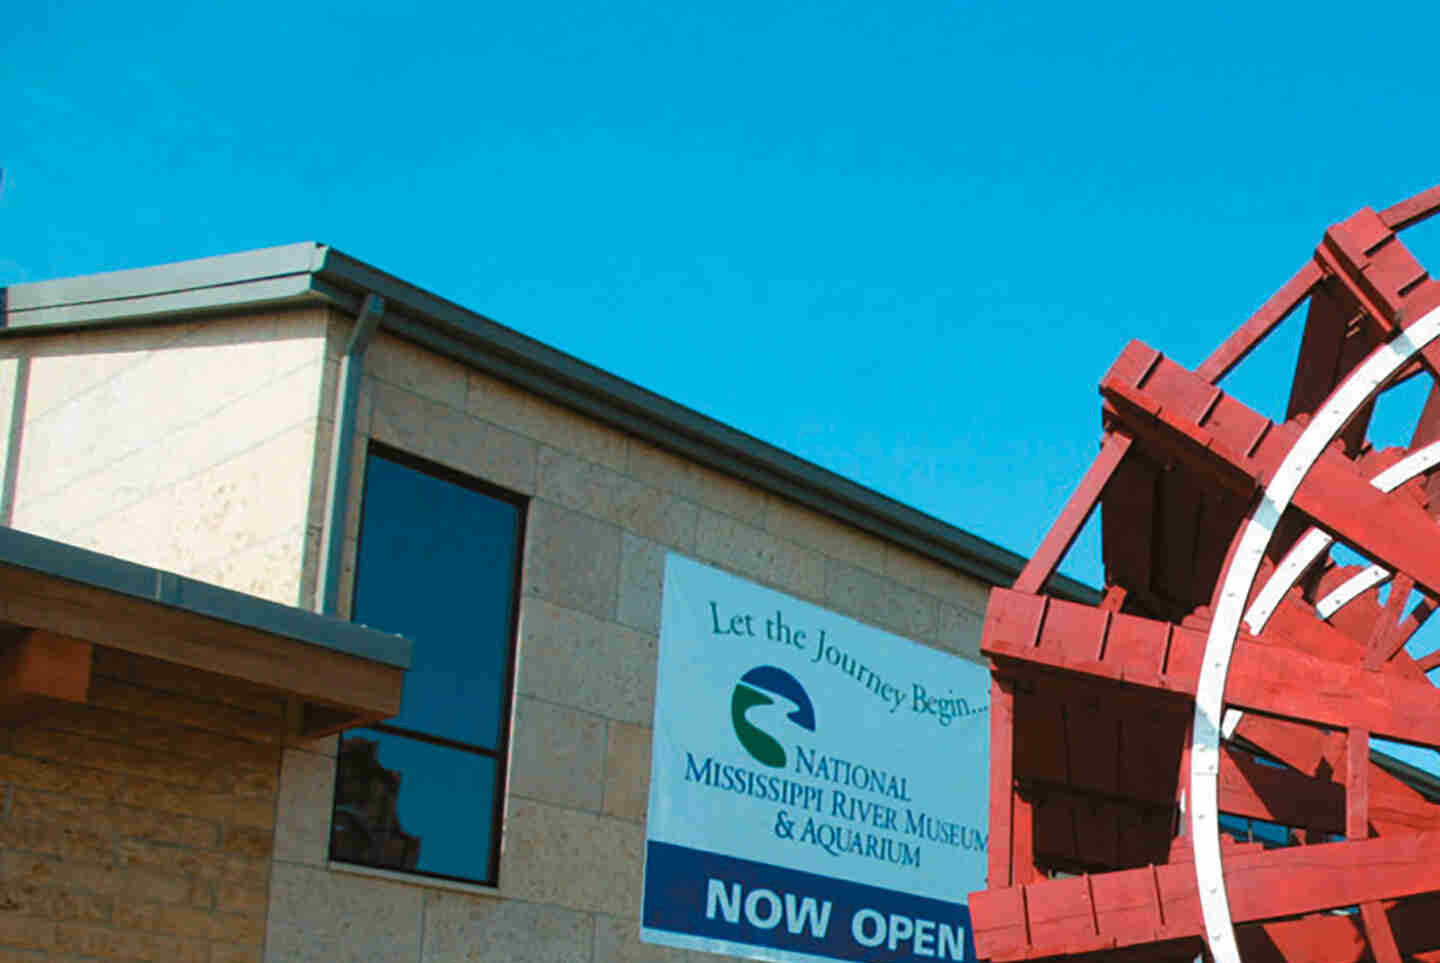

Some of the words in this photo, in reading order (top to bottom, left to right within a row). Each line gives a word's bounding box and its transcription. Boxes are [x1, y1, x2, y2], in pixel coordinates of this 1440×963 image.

[709, 600, 755, 637] Let
[766, 609, 807, 649] the
[810, 630, 906, 713] Journey
[912, 682, 988, 727] Begin...
[685, 752, 824, 812] MISSISSIPPI
[832, 790, 897, 832] RIVER
[795, 745, 912, 802] NATIONAL
[775, 810, 794, 840] &
[800, 817, 920, 868] AQUARIUM
[705, 878, 832, 938] NOW
[851, 908, 965, 962] OPEN
